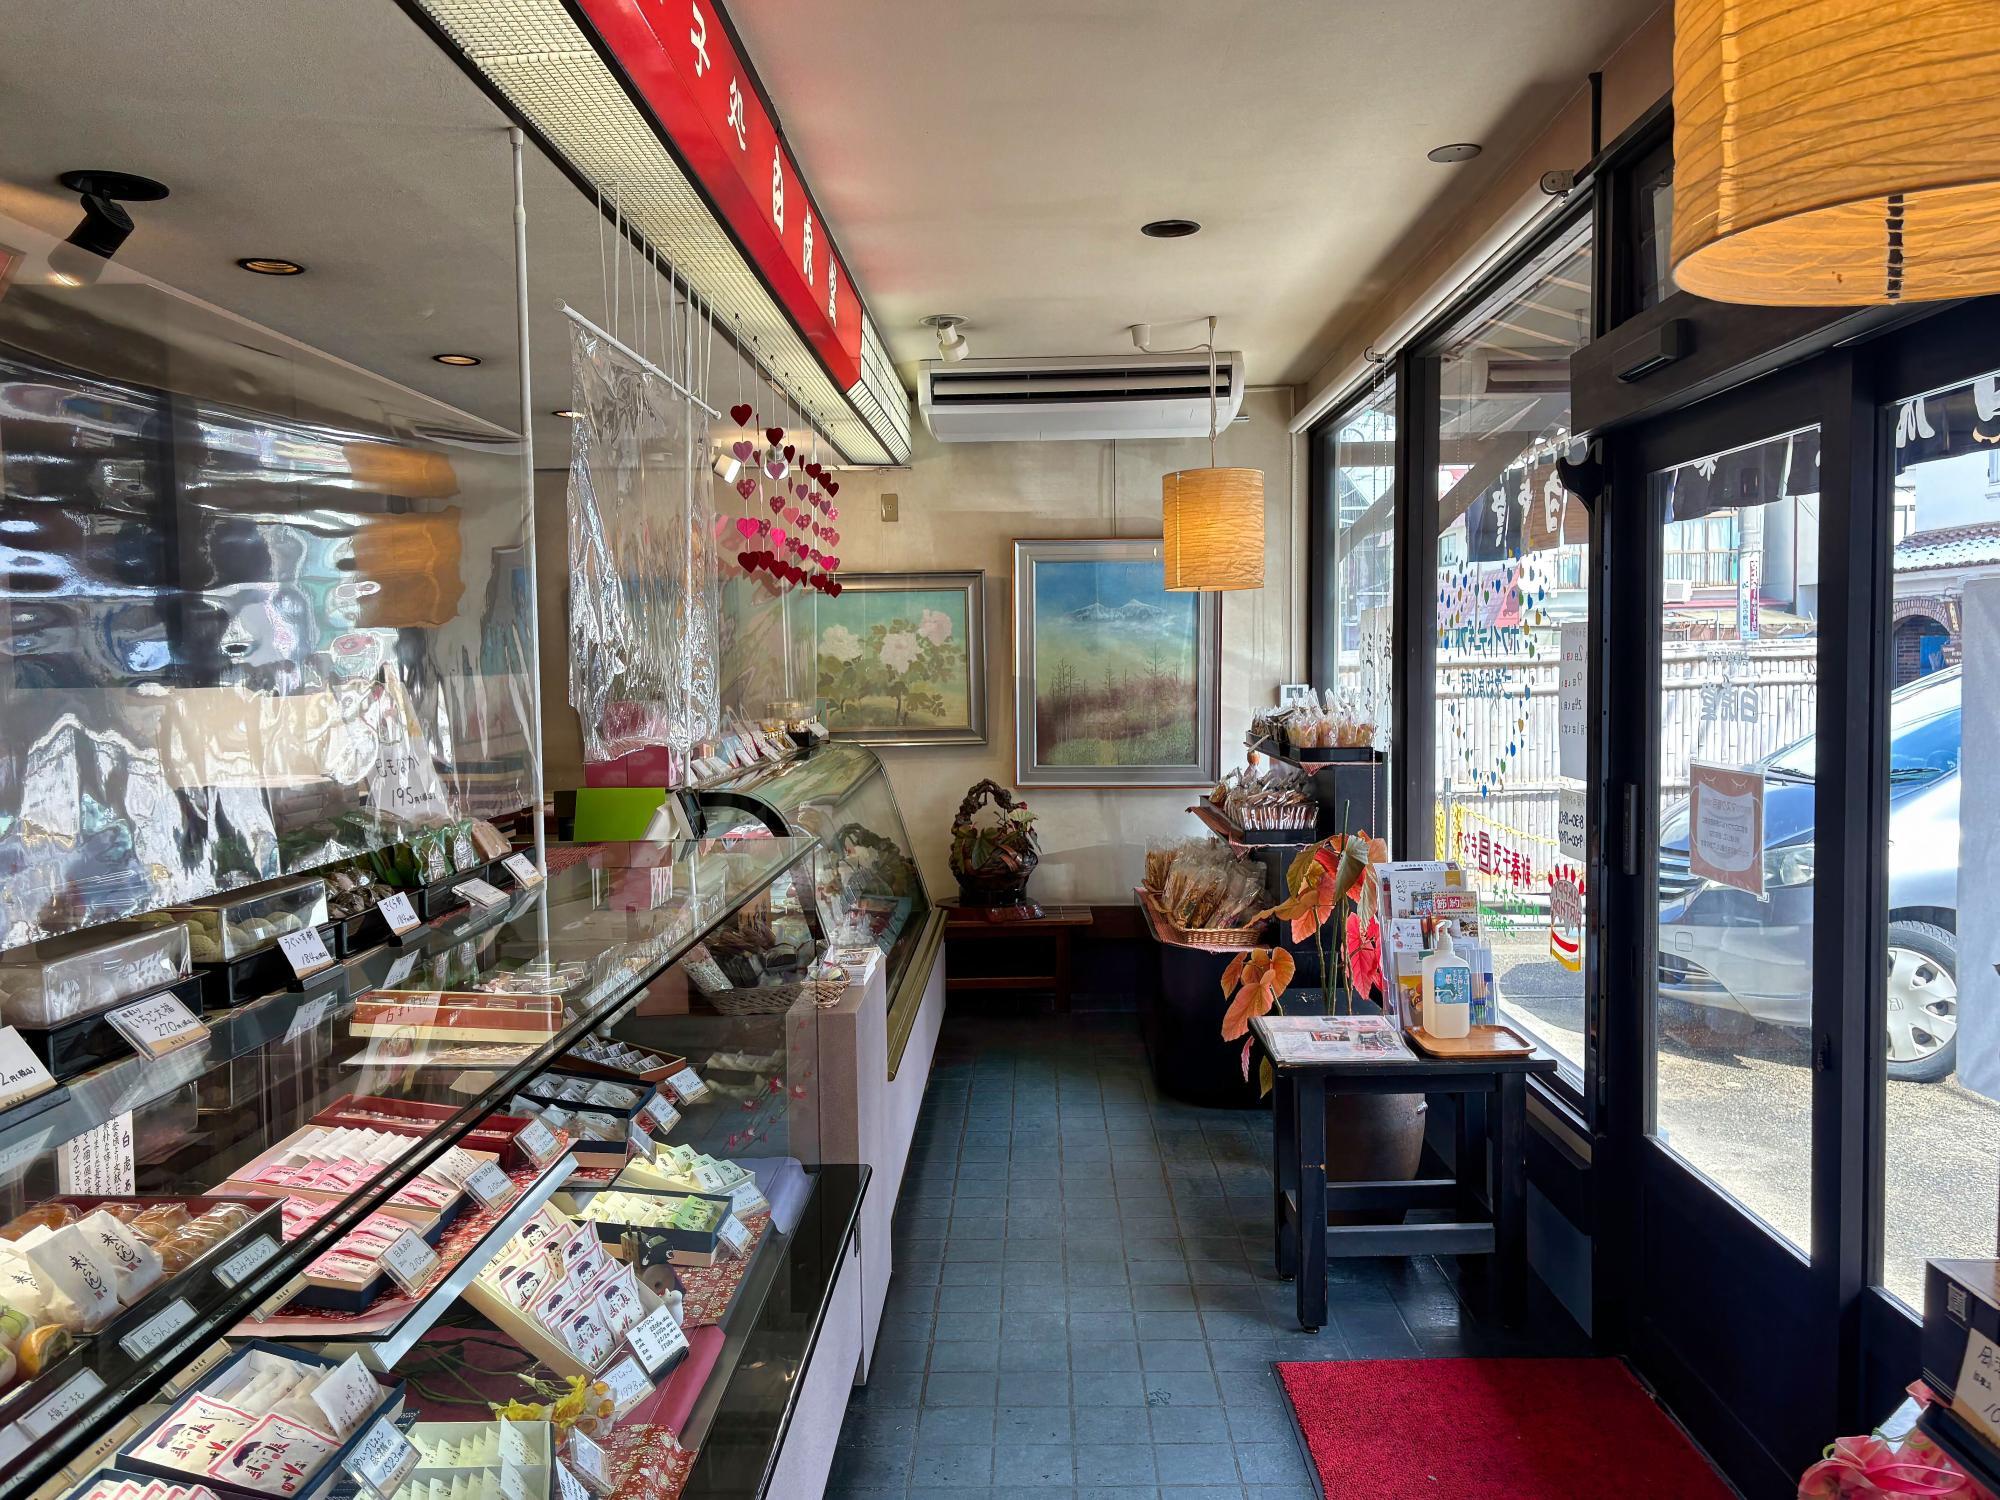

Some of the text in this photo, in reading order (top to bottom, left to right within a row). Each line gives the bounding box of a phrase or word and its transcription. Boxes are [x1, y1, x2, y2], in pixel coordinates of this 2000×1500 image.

[657, 0, 838, 328] 子処白虎堂
[129, 1002, 176, 1029] いちご大福
